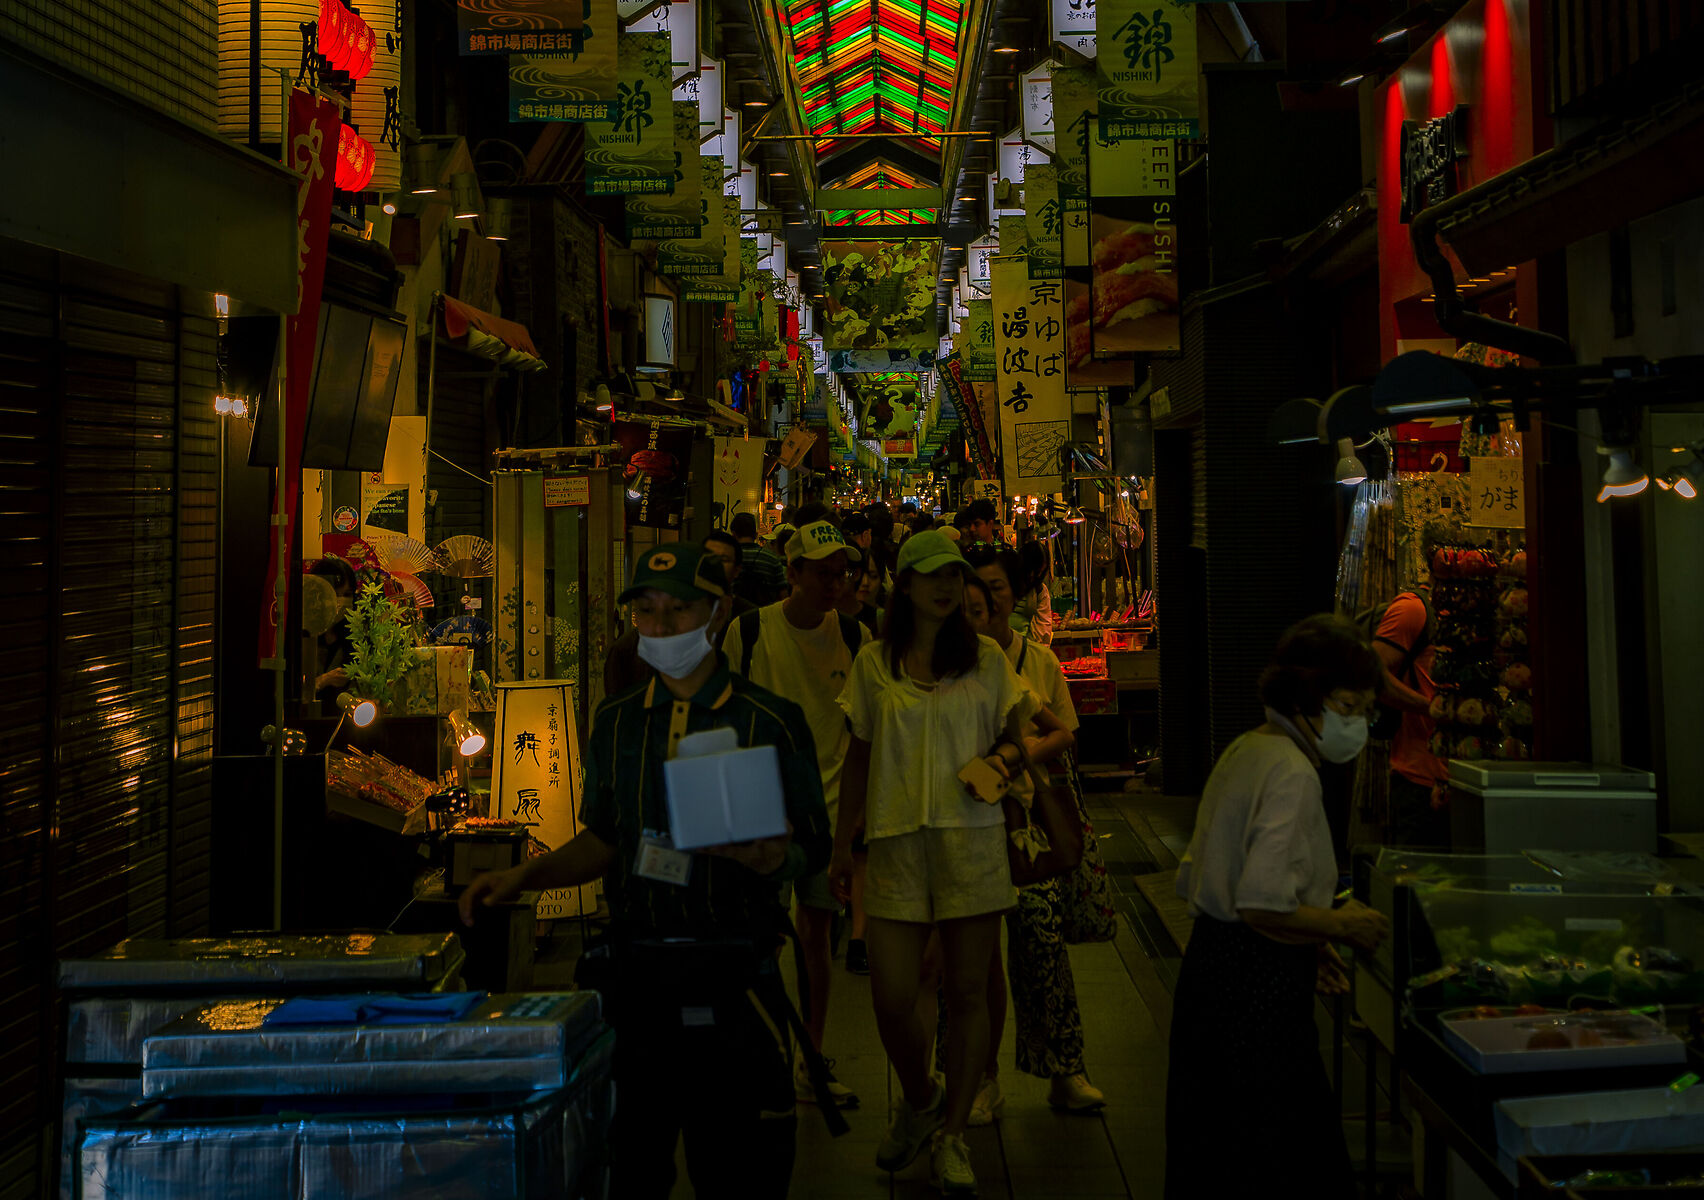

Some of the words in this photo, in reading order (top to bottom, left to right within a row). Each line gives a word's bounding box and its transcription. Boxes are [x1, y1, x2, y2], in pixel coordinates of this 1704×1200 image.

[469, 33, 573, 51] 錦市場商店街
[1112, 9, 1175, 83] 錦
[1113, 71, 1153, 81] NISHIKI
[518, 104, 608, 119] 錦市場商店街
[613, 79, 653, 145] 錦
[1107, 121, 1190, 137] 錦市場商店街
[599, 134, 634, 144] NISHIKI
[1152, 139, 1169, 189] EEF
[593, 180, 667, 193] 錦市場商店街
[1036, 235, 1062, 243] NISHIK
[1153, 202, 1172, 272] SUSHI
[1030, 281, 1065, 377] 京ゆば
[1003, 307, 1033, 414] 湯波吉
[547, 703, 560, 789] 京扇子調進所
[541, 890, 571, 901] NDO
[536, 904, 562, 915] OTO
